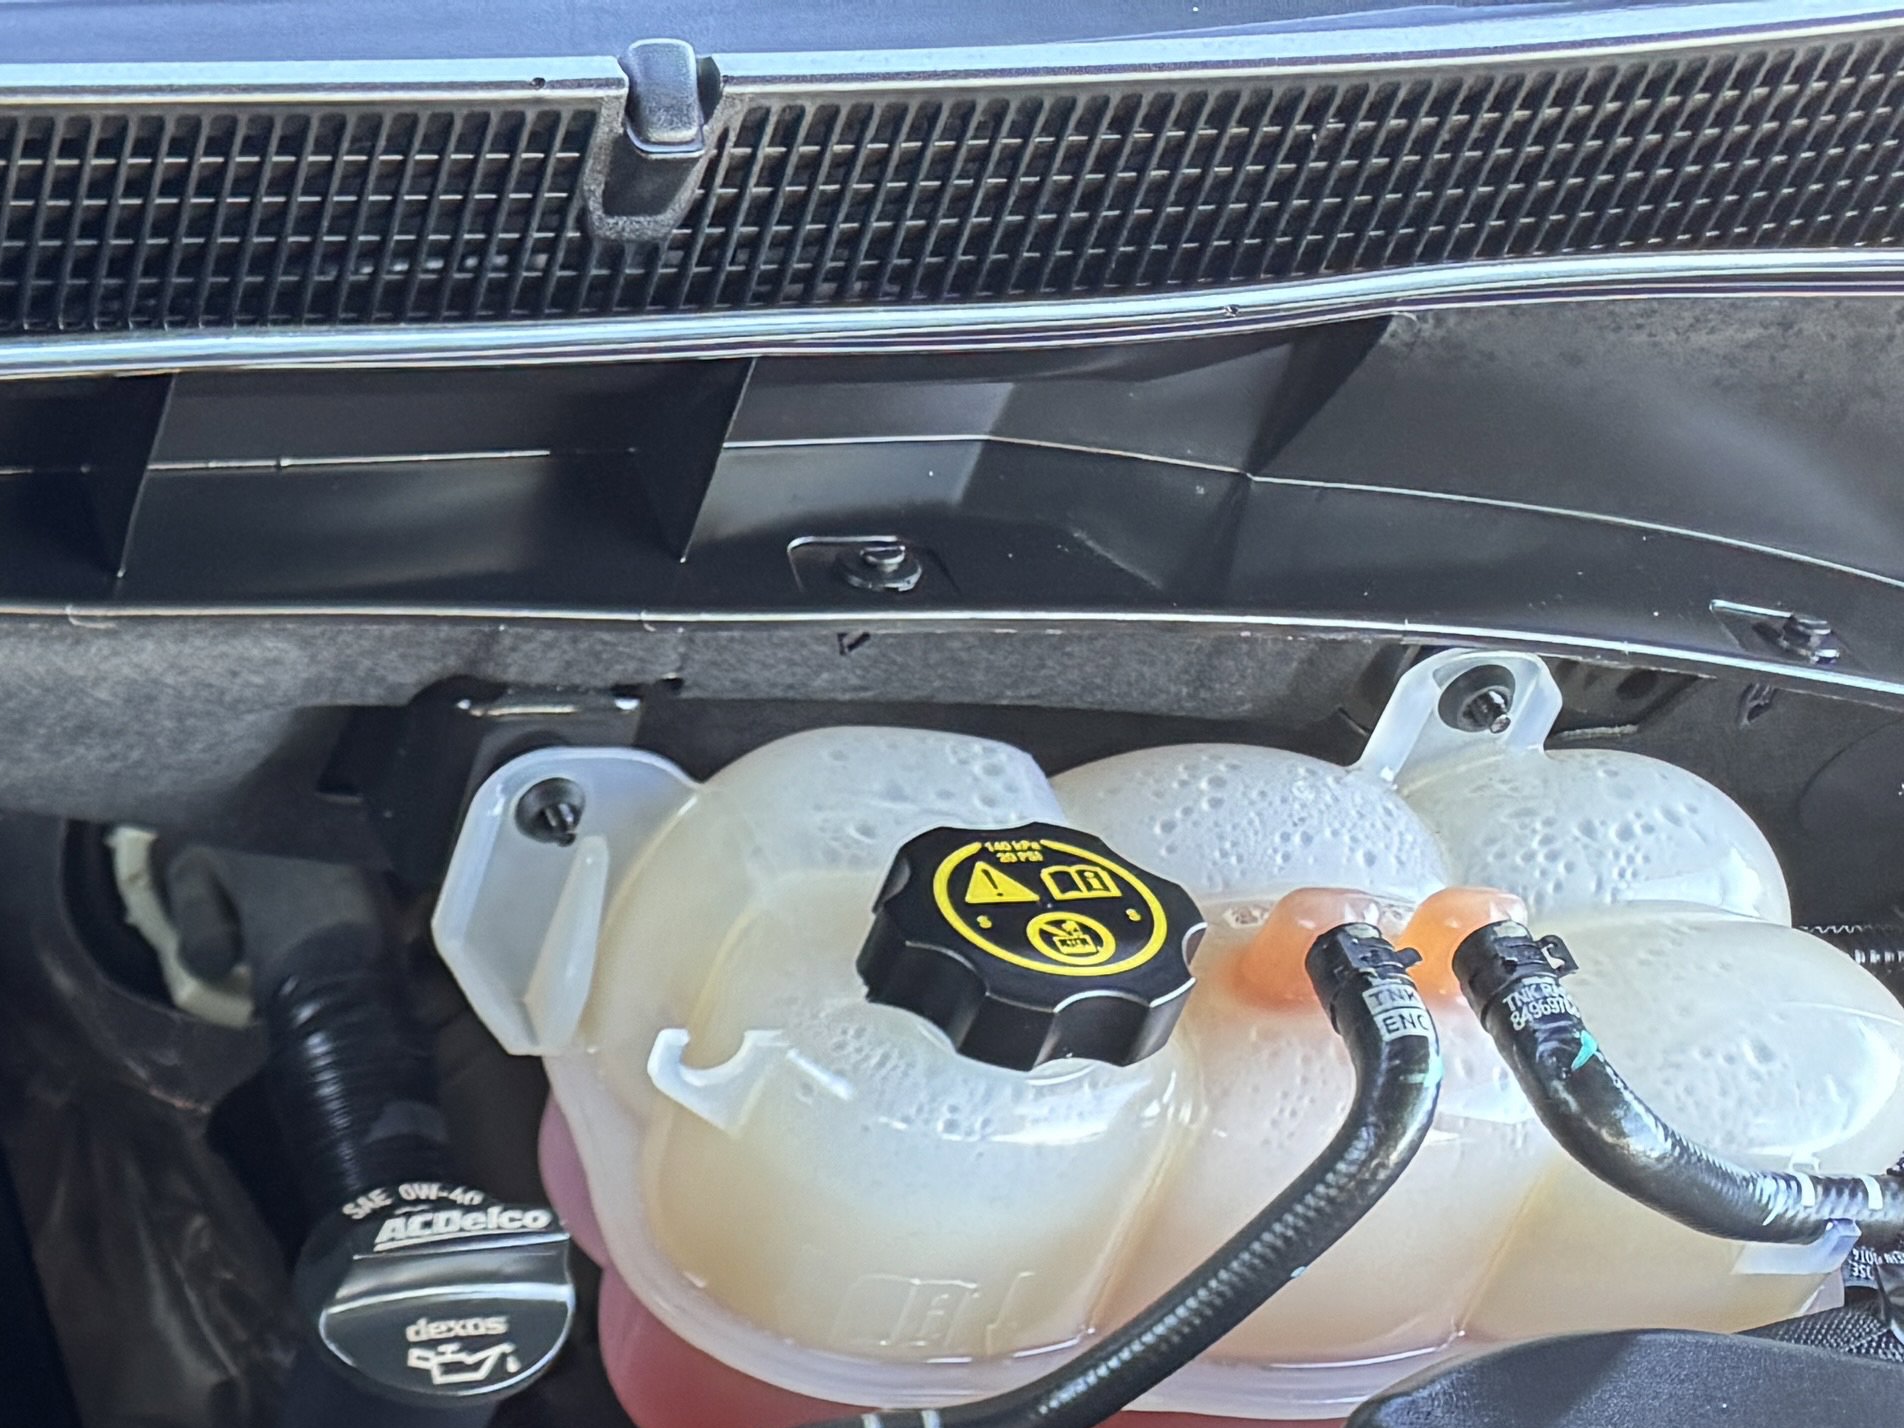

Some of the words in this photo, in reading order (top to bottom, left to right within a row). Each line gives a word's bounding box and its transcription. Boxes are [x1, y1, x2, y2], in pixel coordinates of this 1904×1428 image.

[342, 1187, 394, 1220] SAE
[398, 1181, 485, 1206] 0W-40
[373, 1205, 553, 1245] ACDelco
[405, 1315, 510, 1342] dexos
